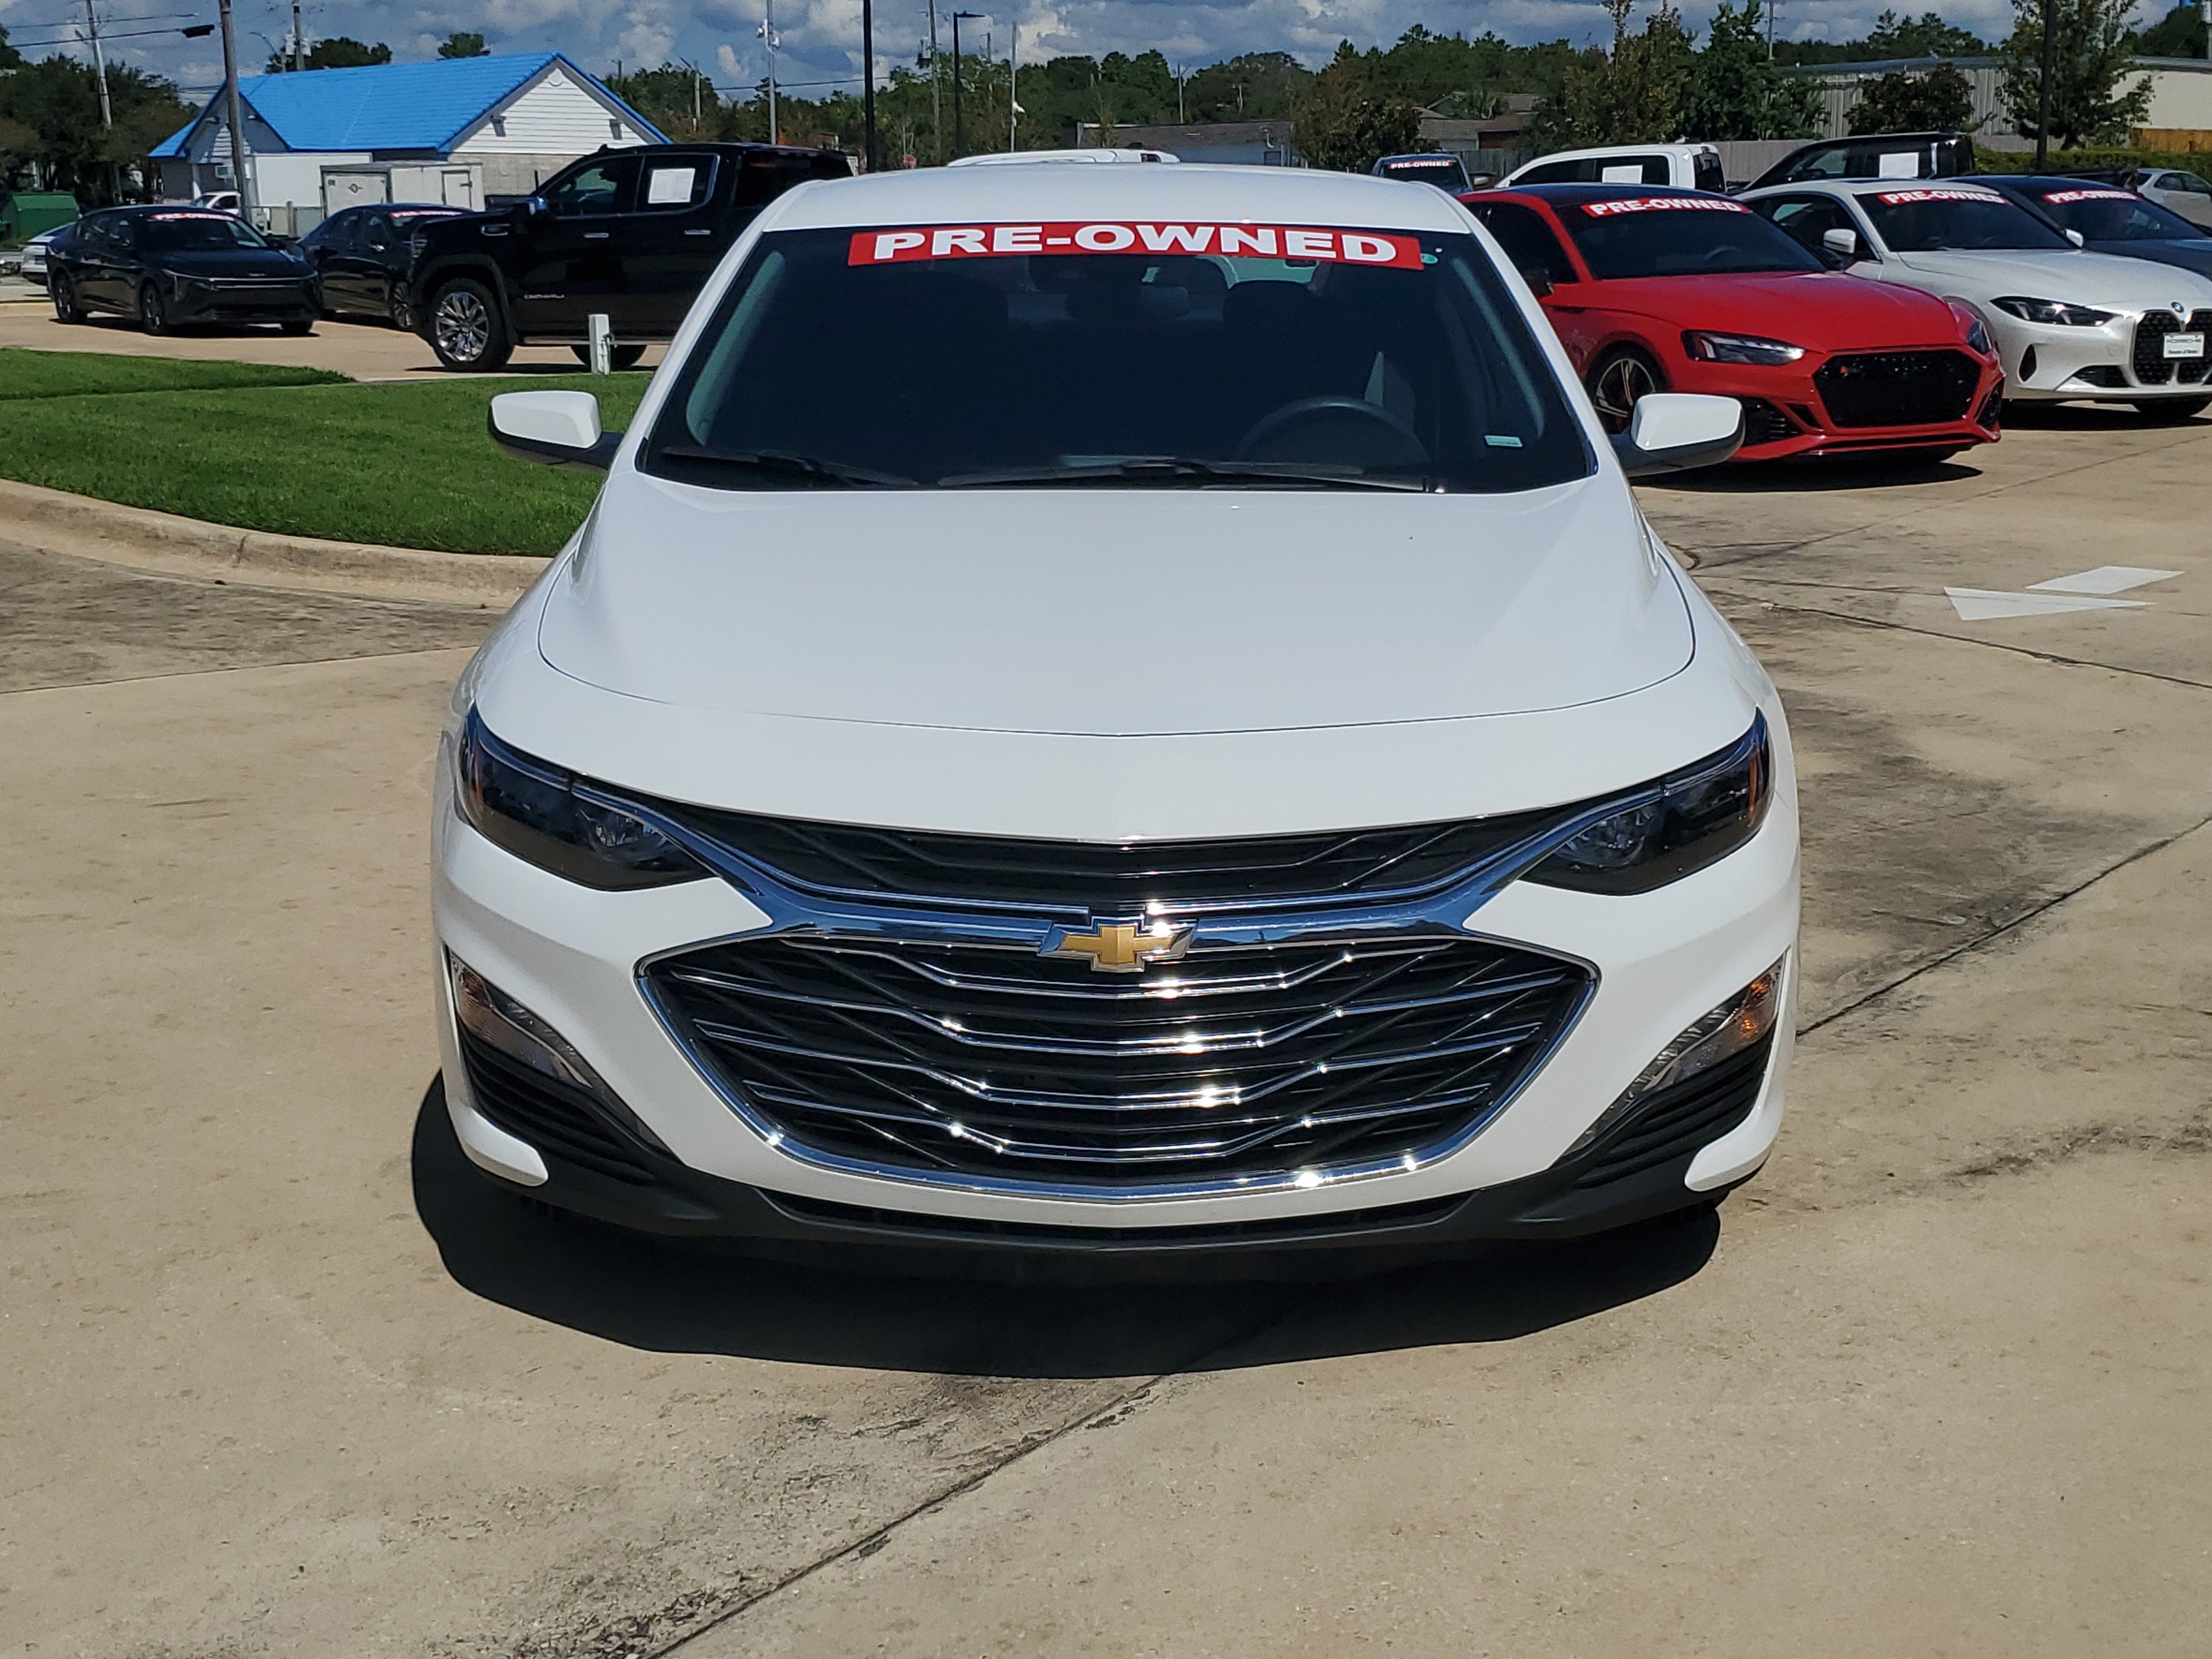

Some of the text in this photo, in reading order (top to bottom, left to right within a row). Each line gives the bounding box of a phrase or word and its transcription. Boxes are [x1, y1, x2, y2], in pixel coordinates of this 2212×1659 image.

[1391, 160, 1449, 169] PRE-OWNED
[1883, 191, 2006, 204] PRE-OWNED
[1589, 199, 1741, 215] PRE-OWNED
[874, 224, 1396, 262] PRE-OWNED
